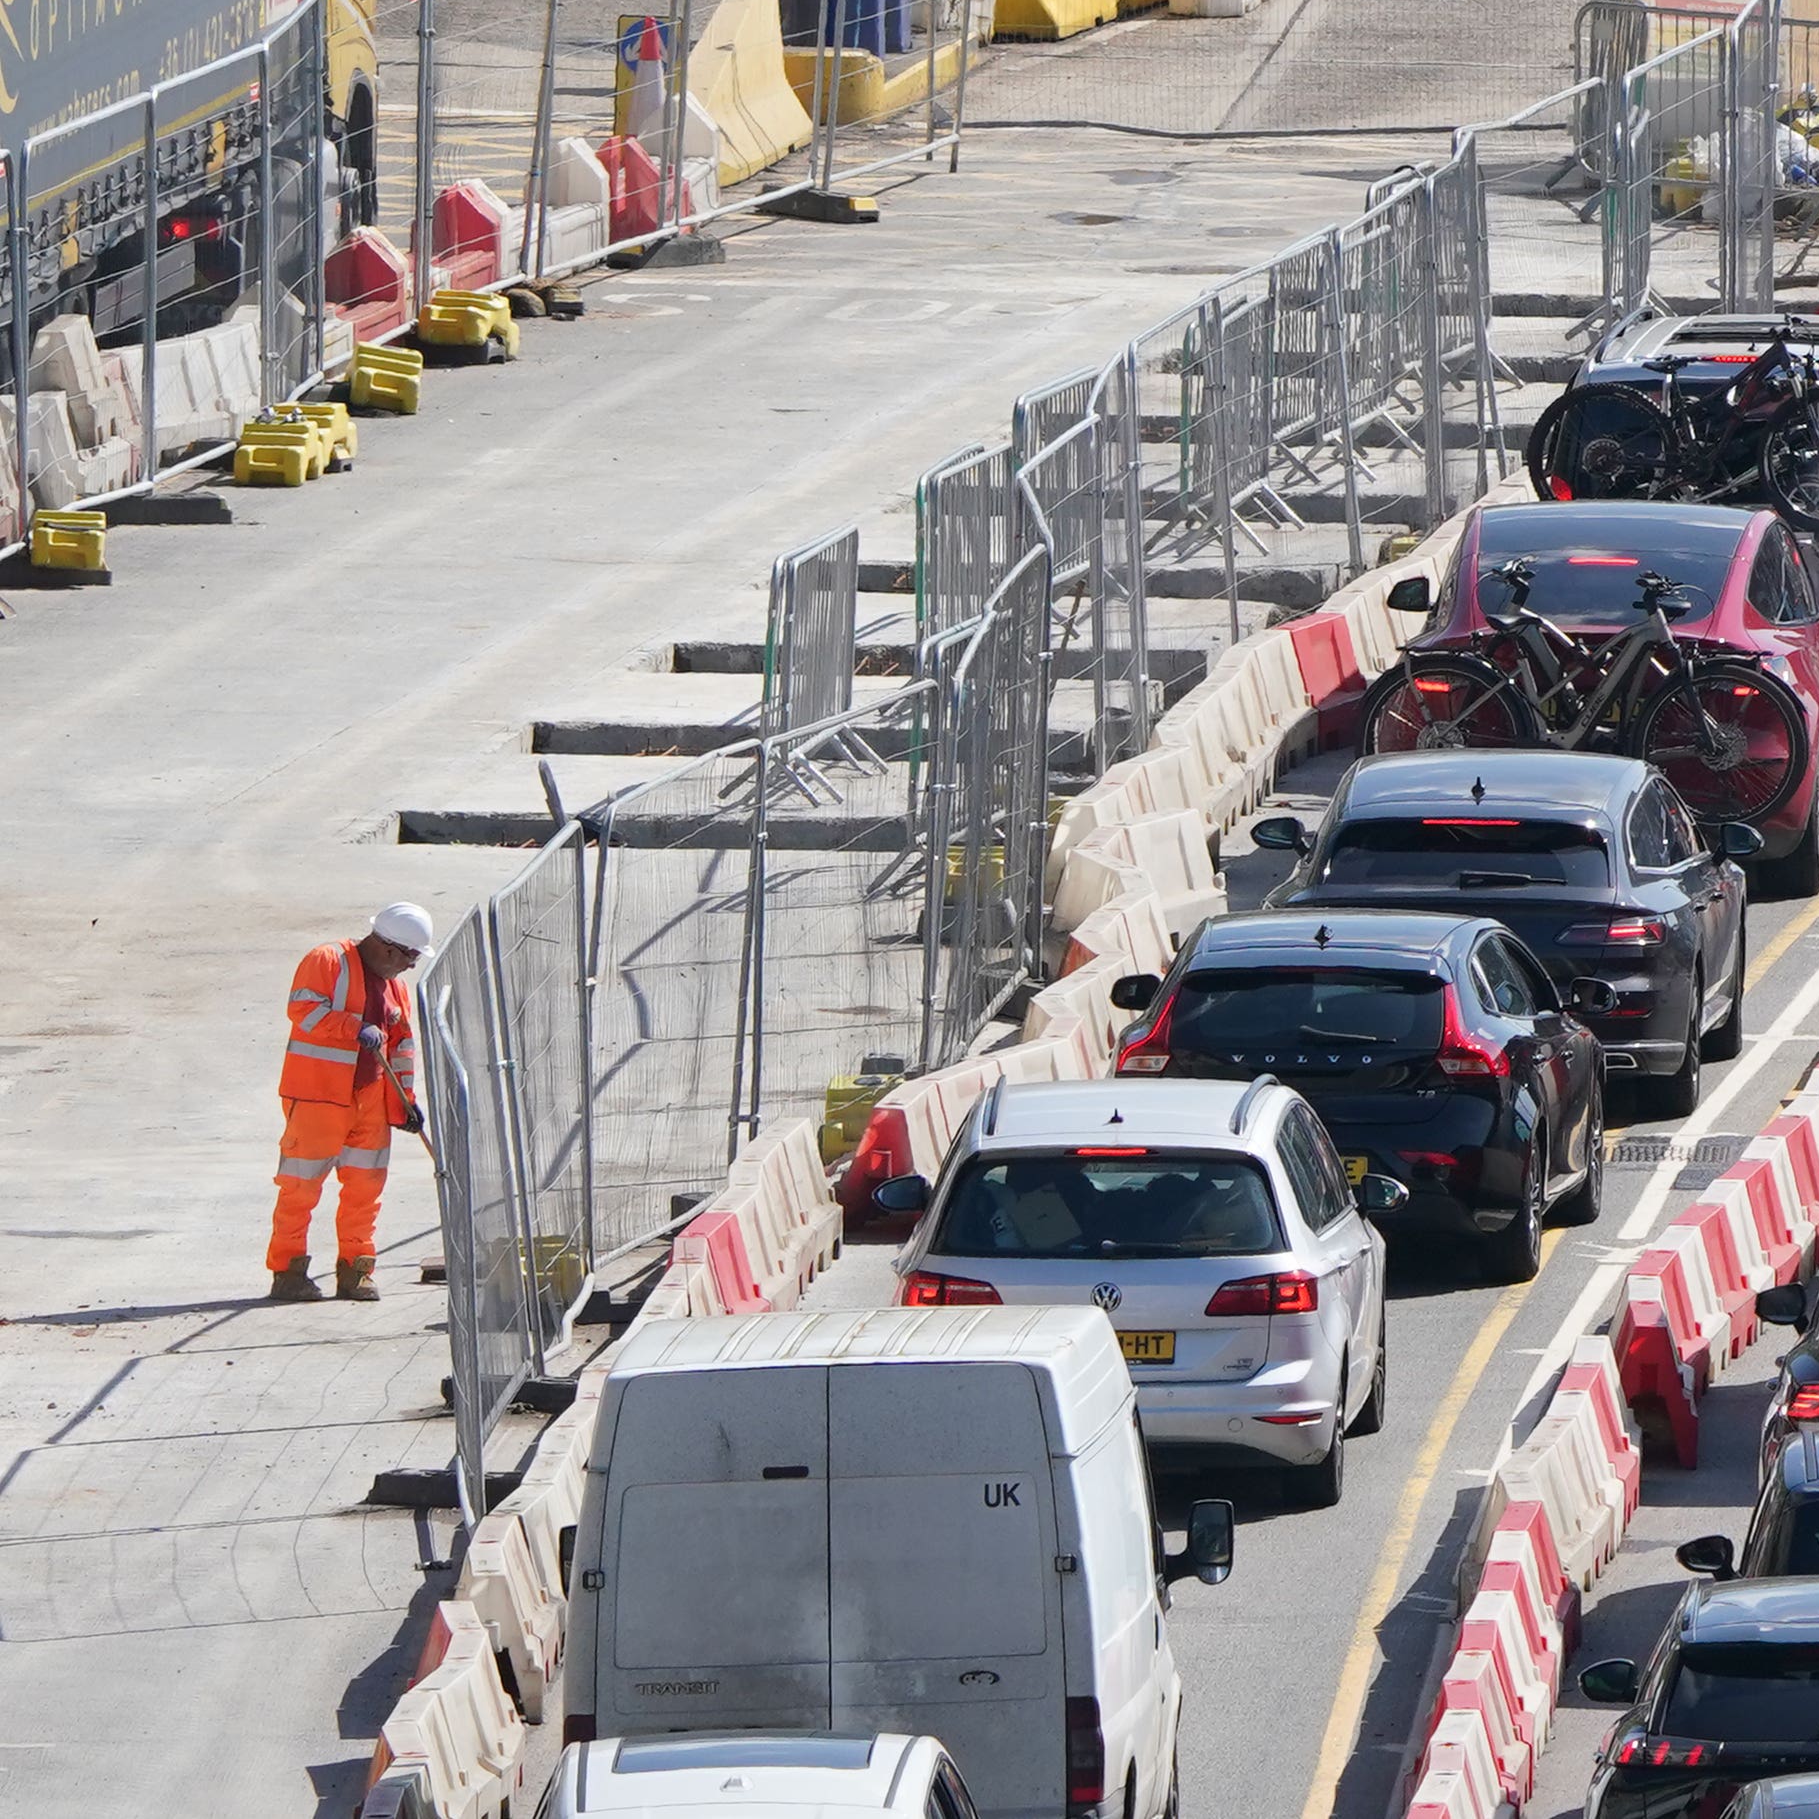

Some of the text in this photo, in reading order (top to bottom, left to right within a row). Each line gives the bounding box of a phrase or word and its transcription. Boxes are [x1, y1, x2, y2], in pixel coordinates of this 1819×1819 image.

[1231, 1052, 1374, 1065] VOLVO
[983, 1481, 1022, 1509] UK
[635, 1680, 721, 1697] TRANSIT
